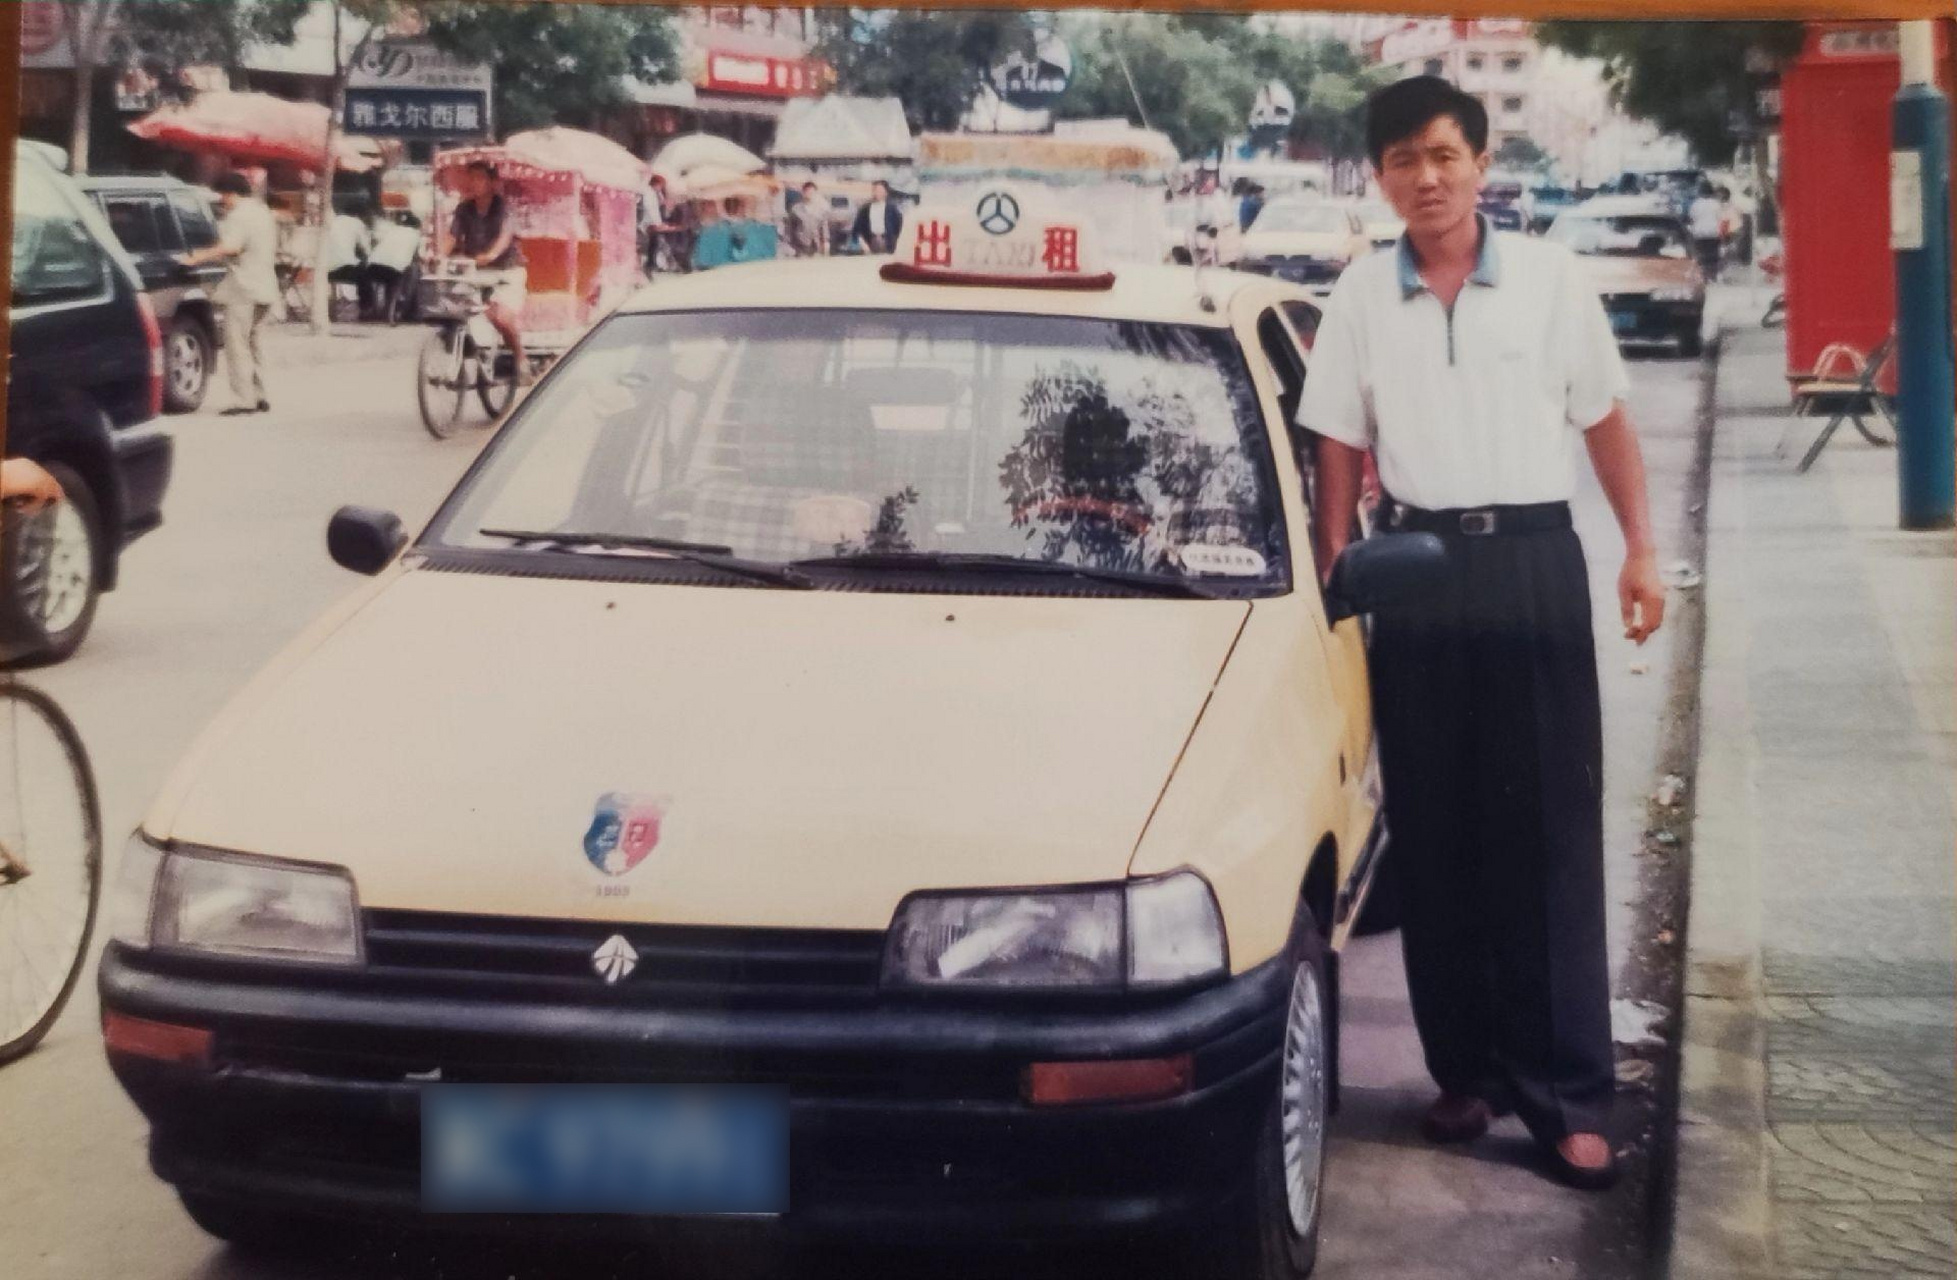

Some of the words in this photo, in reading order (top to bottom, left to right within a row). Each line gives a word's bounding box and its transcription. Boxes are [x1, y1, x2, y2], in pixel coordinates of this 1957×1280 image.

[352, 101, 479, 130] 雅戈尔西服
[914, 220, 952, 267] 出
[1042, 226, 1079, 272] 租
